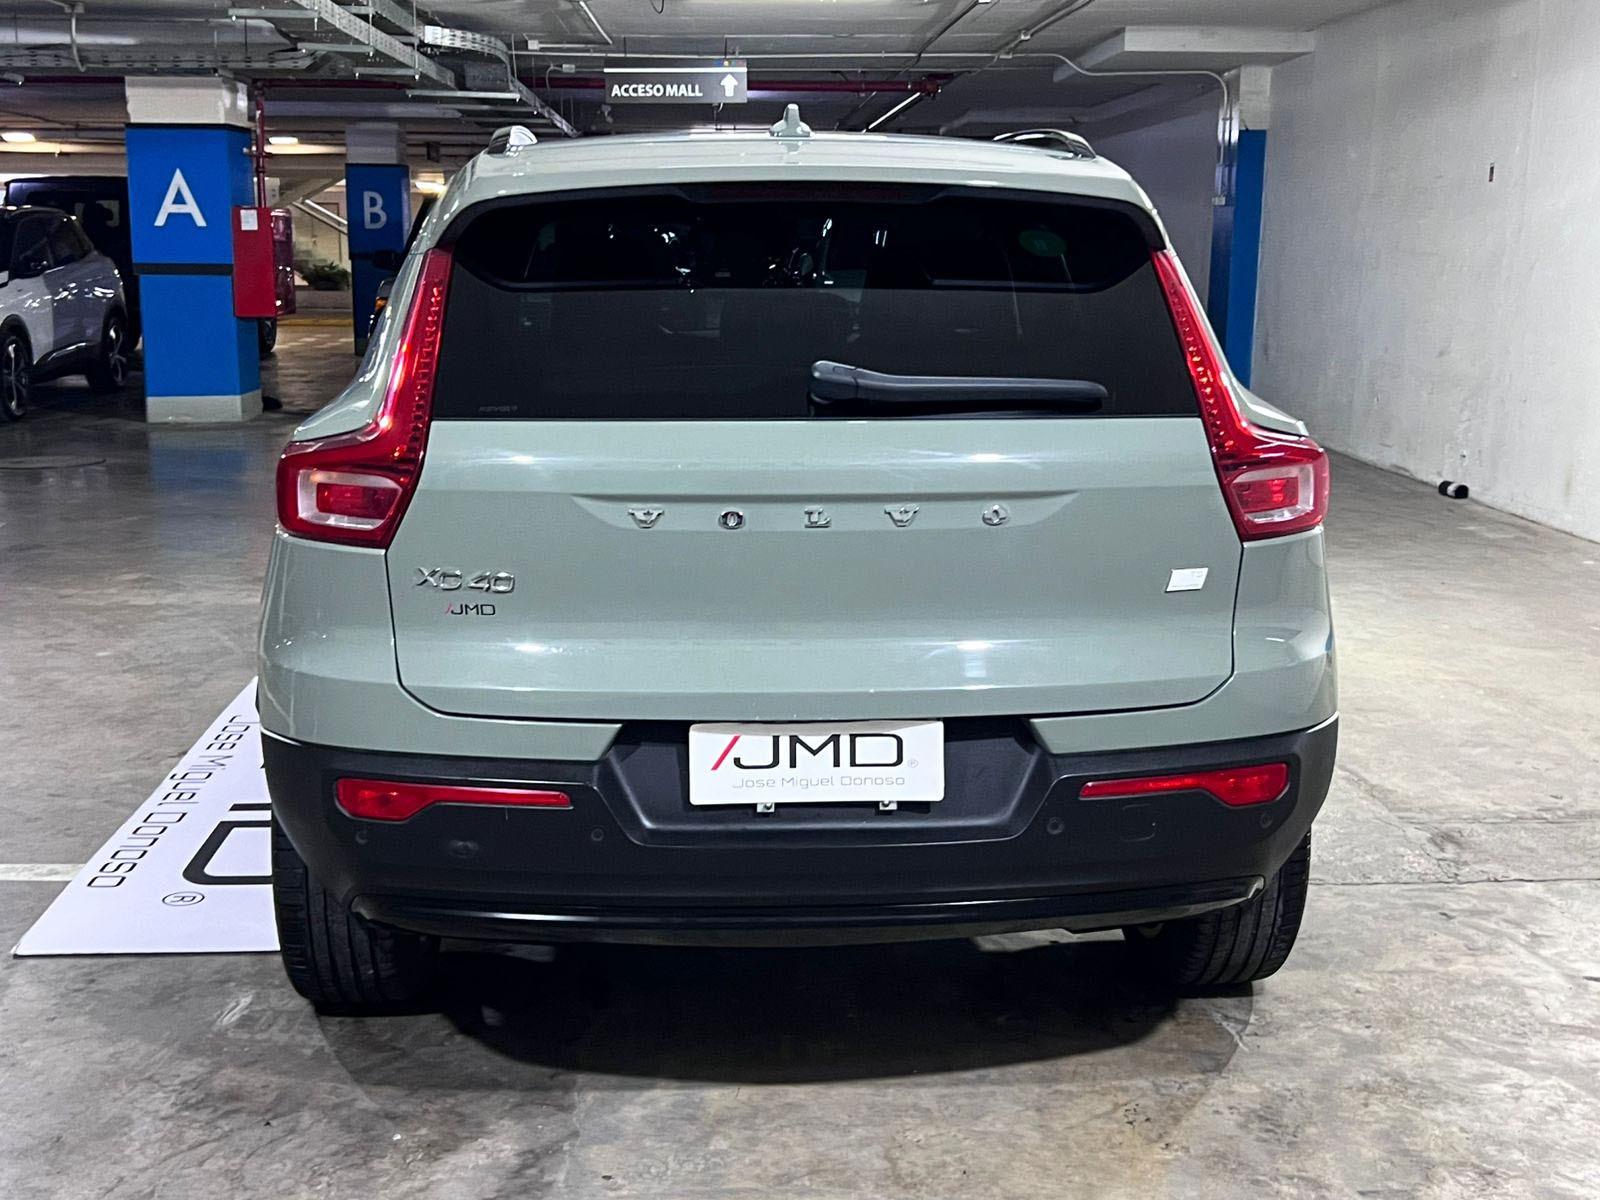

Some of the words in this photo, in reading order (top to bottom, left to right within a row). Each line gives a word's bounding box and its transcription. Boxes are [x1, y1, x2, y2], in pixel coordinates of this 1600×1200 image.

[611, 83, 664, 97] ACCESO
[666, 83, 703, 97] MALL
[154, 168, 207, 227] A
[363, 191, 387, 229] B
[627, 504, 1010, 530] VOLVO
[157, 755, 234, 806] Miguel
[732, 777, 776, 789] Jose
[781, 776, 834, 789] Miguel
[841, 775, 905, 787] Donoso
[87, 811, 188, 888] Donoso
